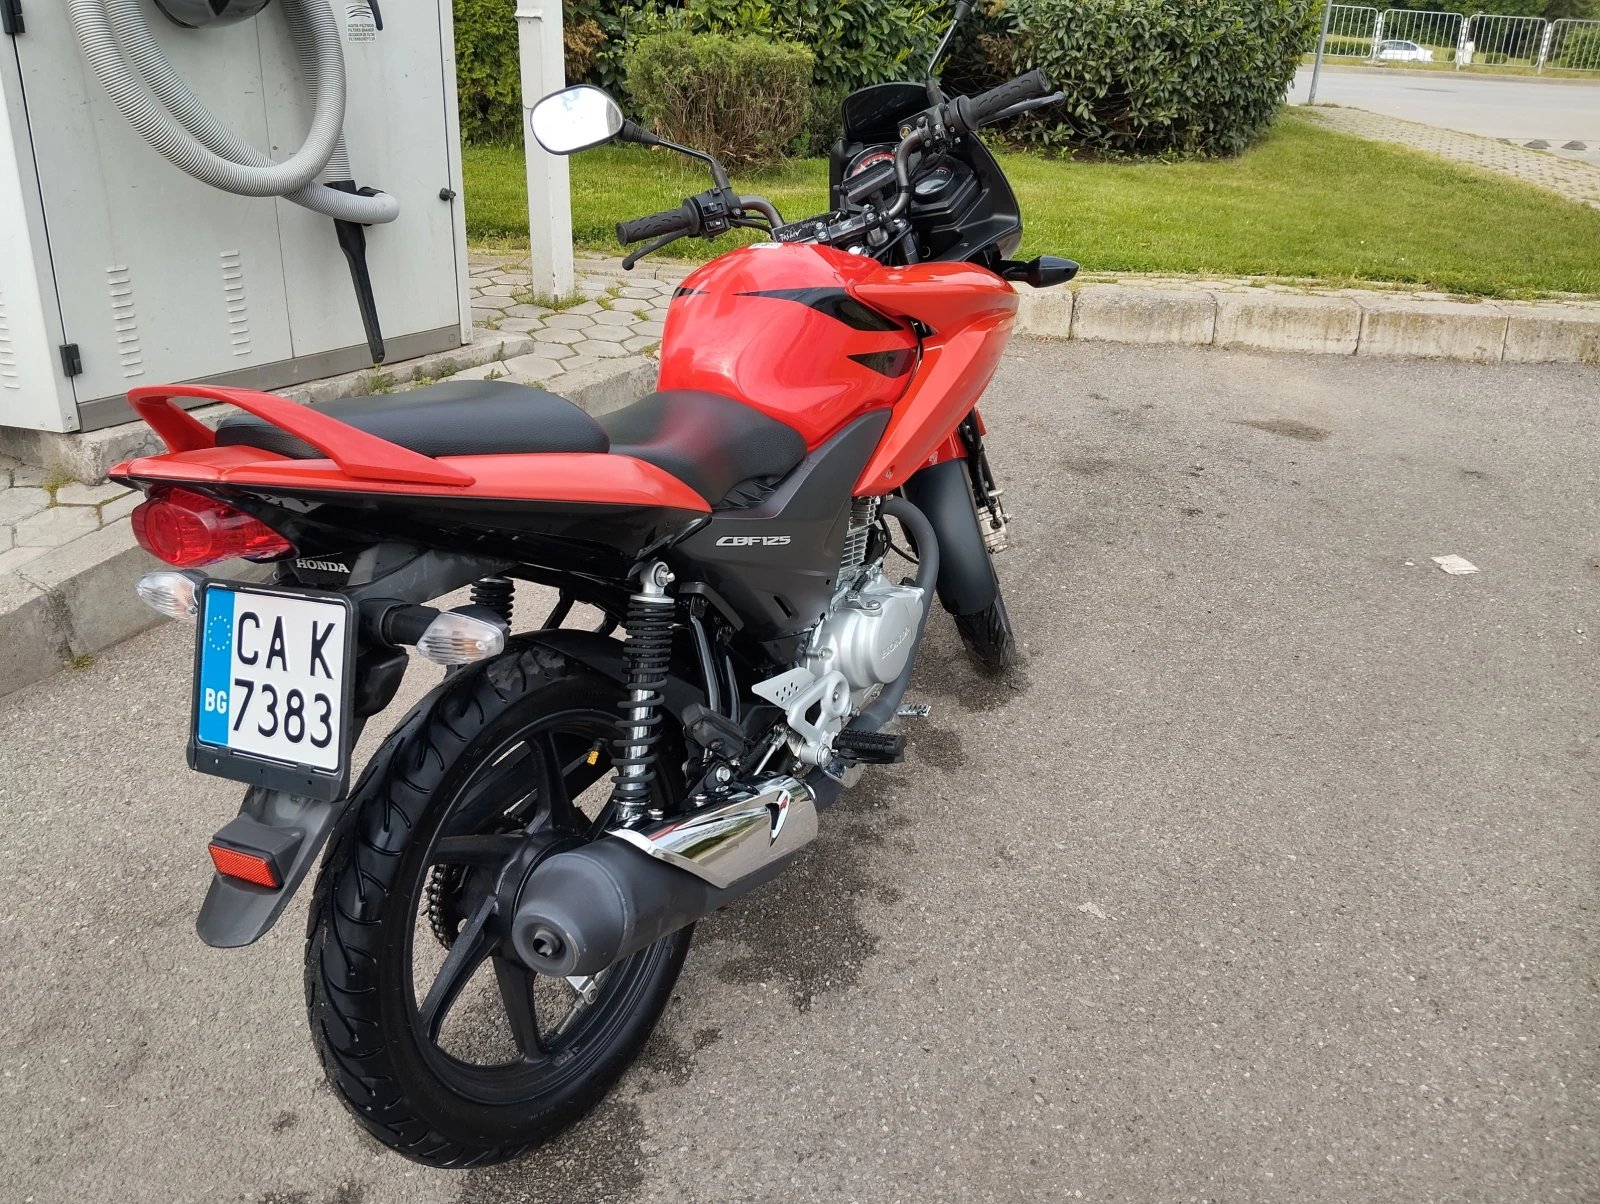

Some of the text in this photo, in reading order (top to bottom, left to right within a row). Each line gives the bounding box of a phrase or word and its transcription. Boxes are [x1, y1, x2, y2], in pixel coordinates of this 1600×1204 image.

[715, 536, 790, 546] CBF125
[296, 558, 350, 573] HONDA
[237, 611, 336, 680] CA K
[204, 687, 228, 714] BG
[232, 678, 333, 748] 7383
